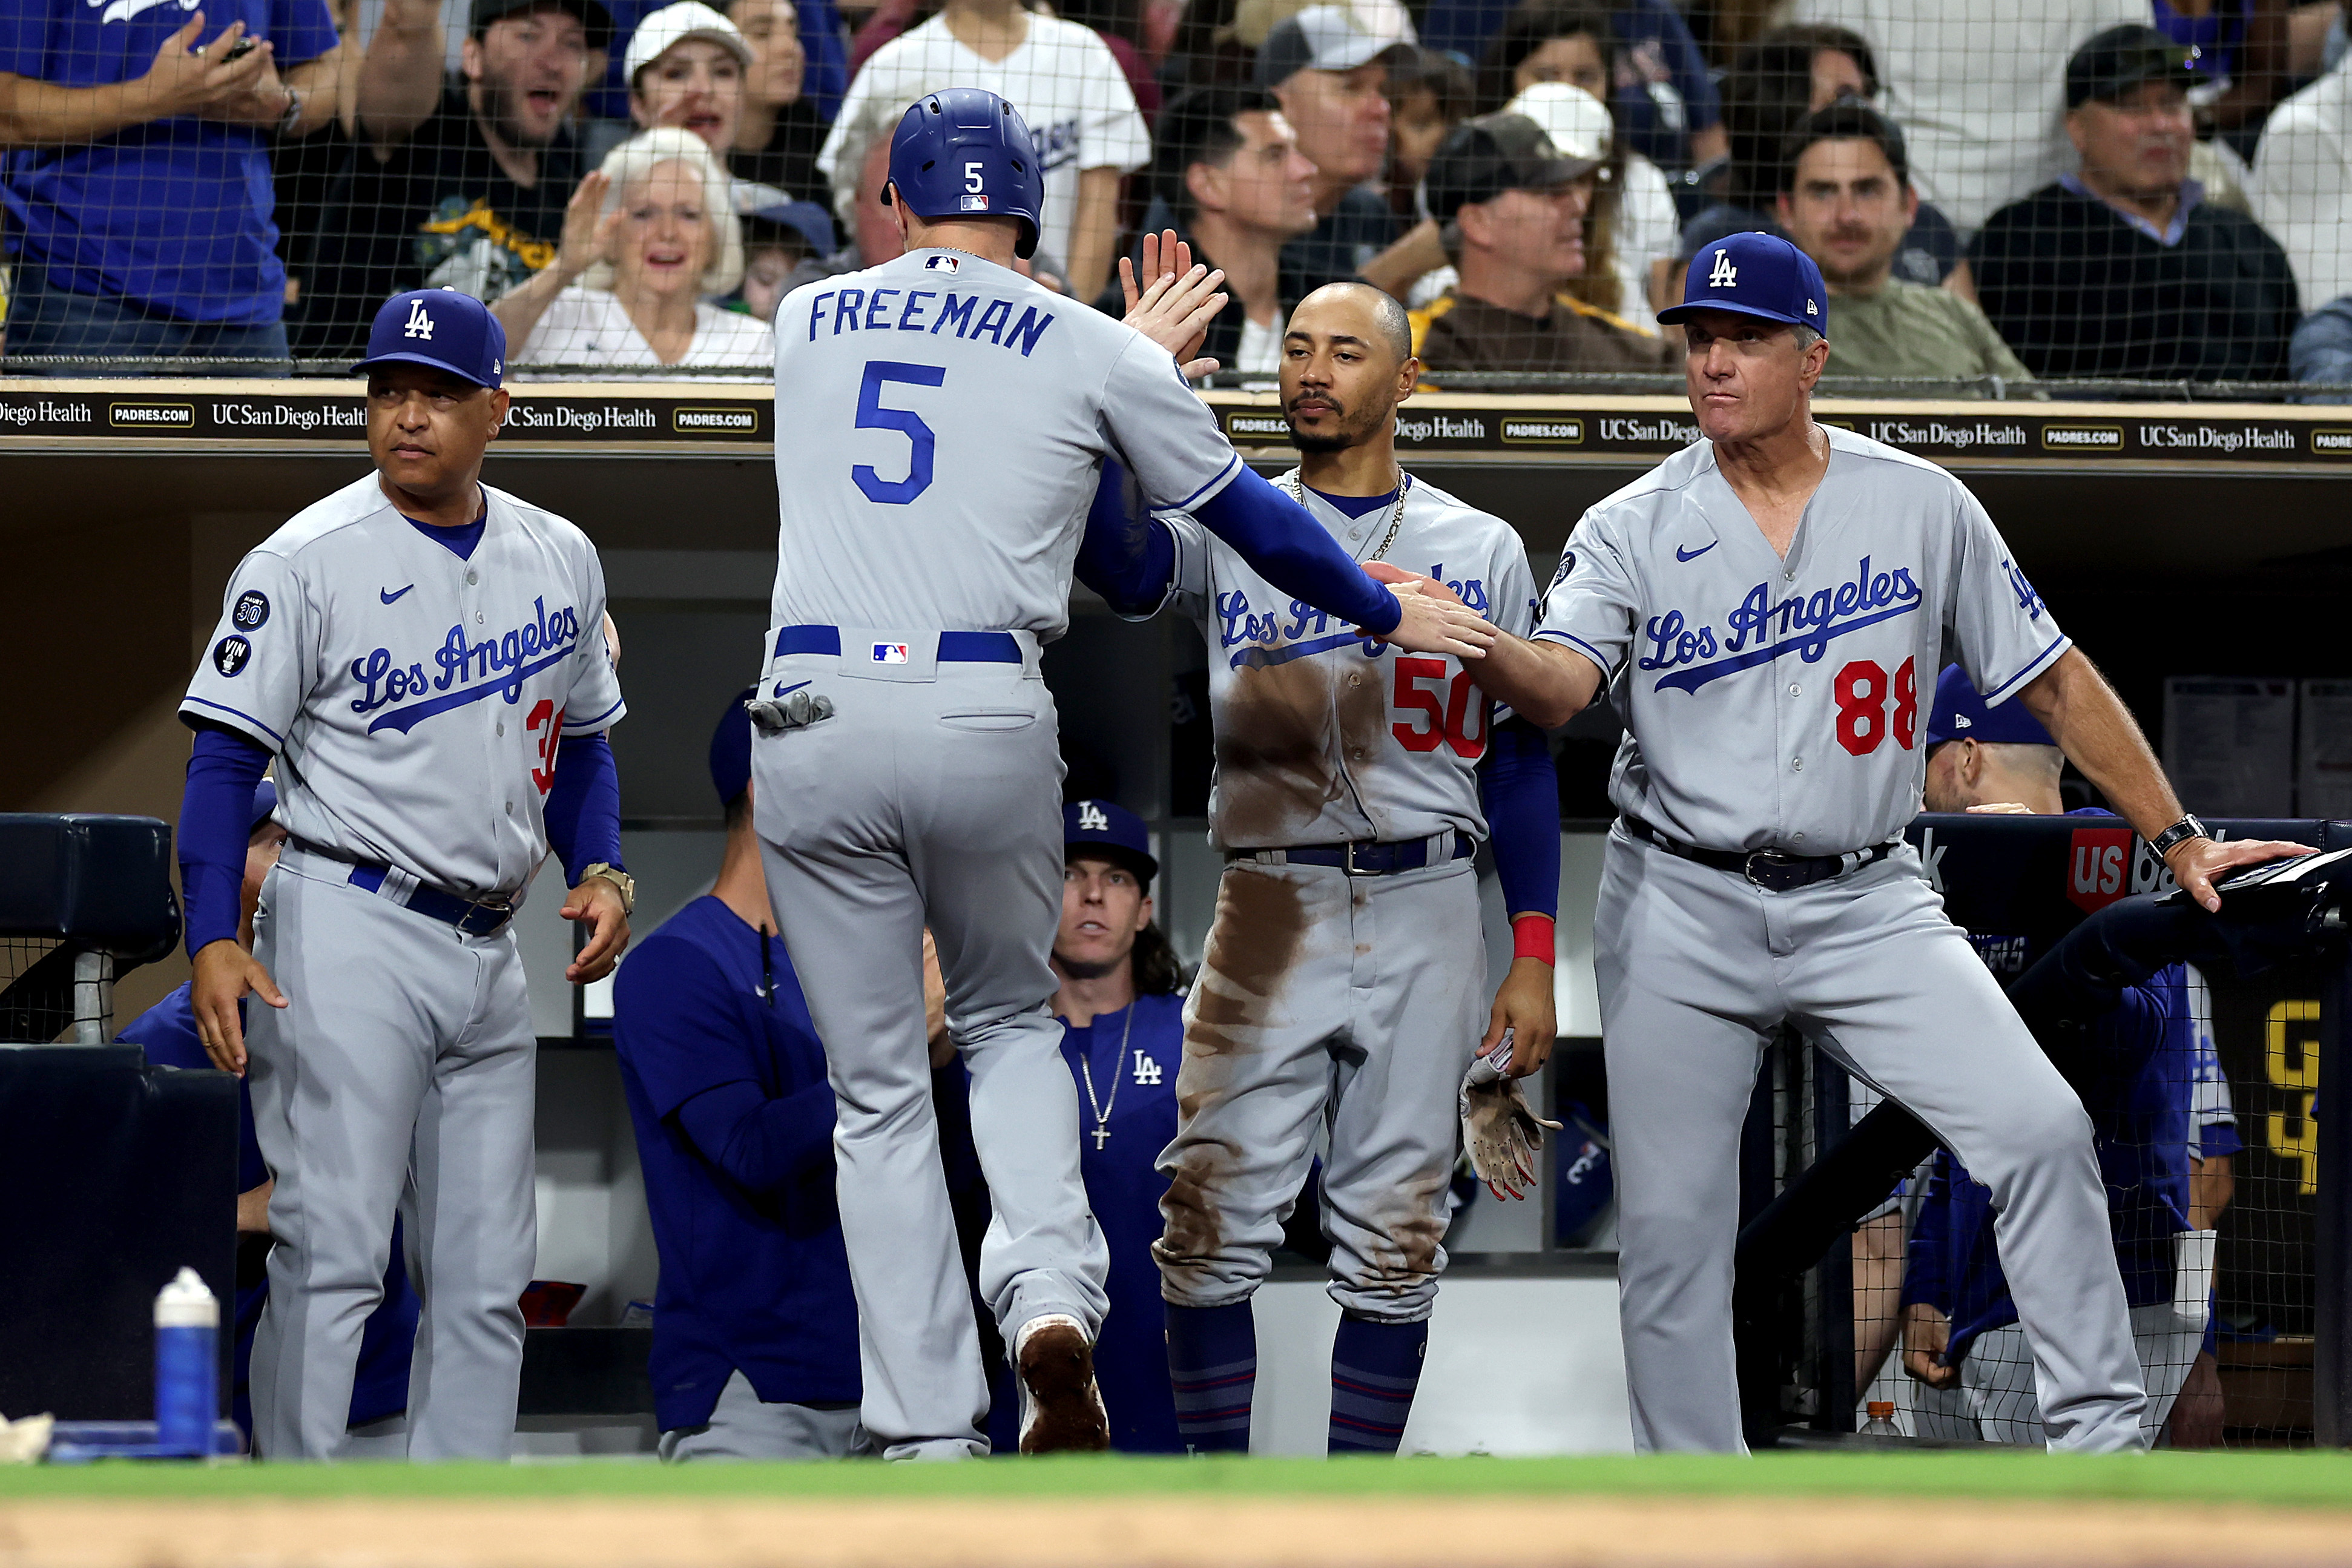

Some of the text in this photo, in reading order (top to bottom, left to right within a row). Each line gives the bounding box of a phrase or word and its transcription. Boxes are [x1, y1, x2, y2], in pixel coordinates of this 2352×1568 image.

[965, 162, 983, 193] 5
[1709, 249, 1737, 287] LA
[404, 299, 434, 340] LA
[809, 289, 1055, 358] FREEMAN
[0, 401, 91, 426] iego Health
[115, 409, 189, 421] PADRES.COM
[212, 404, 239, 425] UC
[241, 404, 272, 425] San
[274, 404, 320, 430] Diego
[522, 406, 554, 427] San
[556, 406, 602, 432] Diego
[604, 407, 656, 428] Health
[679, 414, 752, 427] PADRES.COM
[1232, 419, 1290, 432] PADRES.C
[1433, 416, 1485, 438] Health
[851, 361, 946, 505] 5
[1506, 423, 1578, 438] PADRES.COM
[1599, 418, 1704, 446] UC San Diego
[1870, 421, 2026, 449] UC San Diego Health
[2047, 430, 2119, 444] PADRES.COM
[2140, 426, 2294, 453] UC San Diego Health
[237, 602, 262, 625] 30
[244, 596, 264, 606] MAURY
[1639, 555, 1922, 671] Los Angeles
[1216, 590, 1277, 648] Los
[225, 639, 246, 657] VIN
[351, 595, 579, 713] Los Angeles
[1392, 657, 1491, 758] 50
[1834, 654, 1917, 757] 88
[1078, 800, 1108, 831] LA
[2075, 846, 2123, 895] us
[1133, 1049, 1162, 1084] LA
